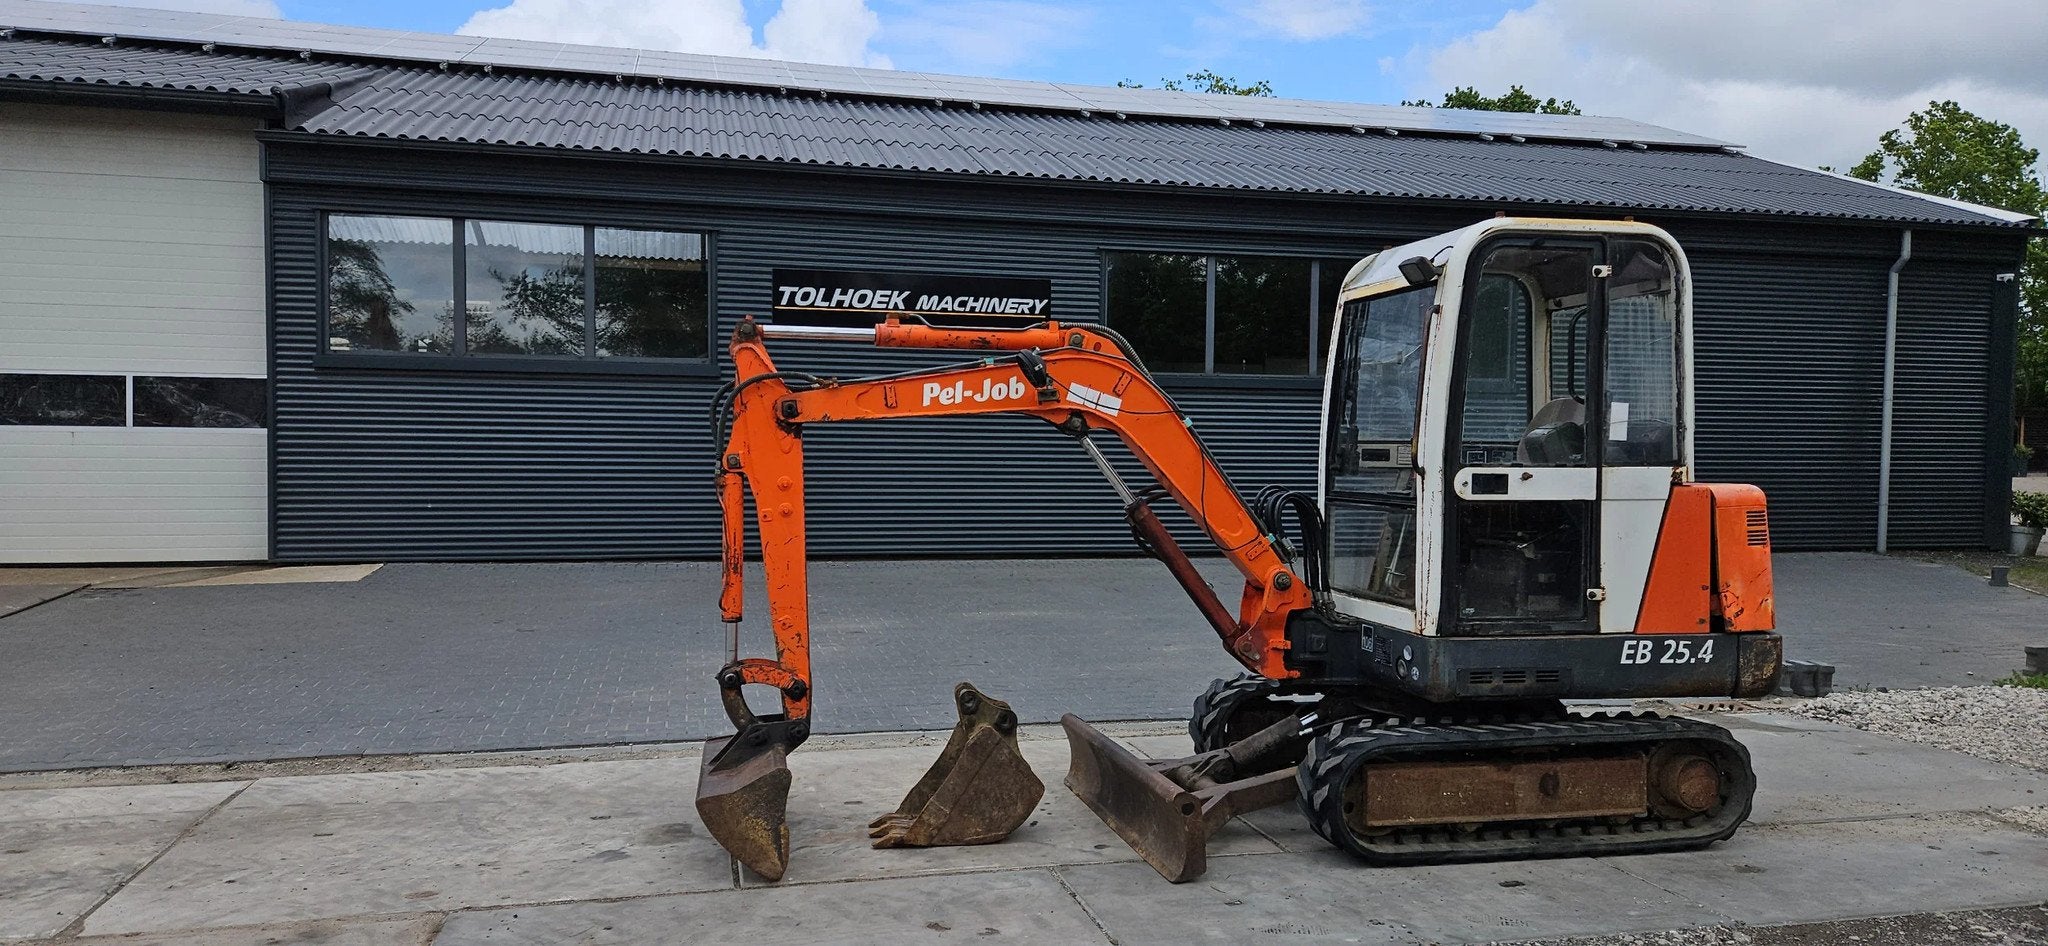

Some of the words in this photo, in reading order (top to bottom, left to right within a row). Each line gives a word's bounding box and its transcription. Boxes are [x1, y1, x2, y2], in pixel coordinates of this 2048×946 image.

[779, 286, 910, 310] TOLHOEK
[915, 295, 1048, 315] MACHINERY
[923, 376, 1025, 406] Pel-Job
[1620, 640, 1653, 664] EB
[1660, 639, 1714, 664] 25.4
